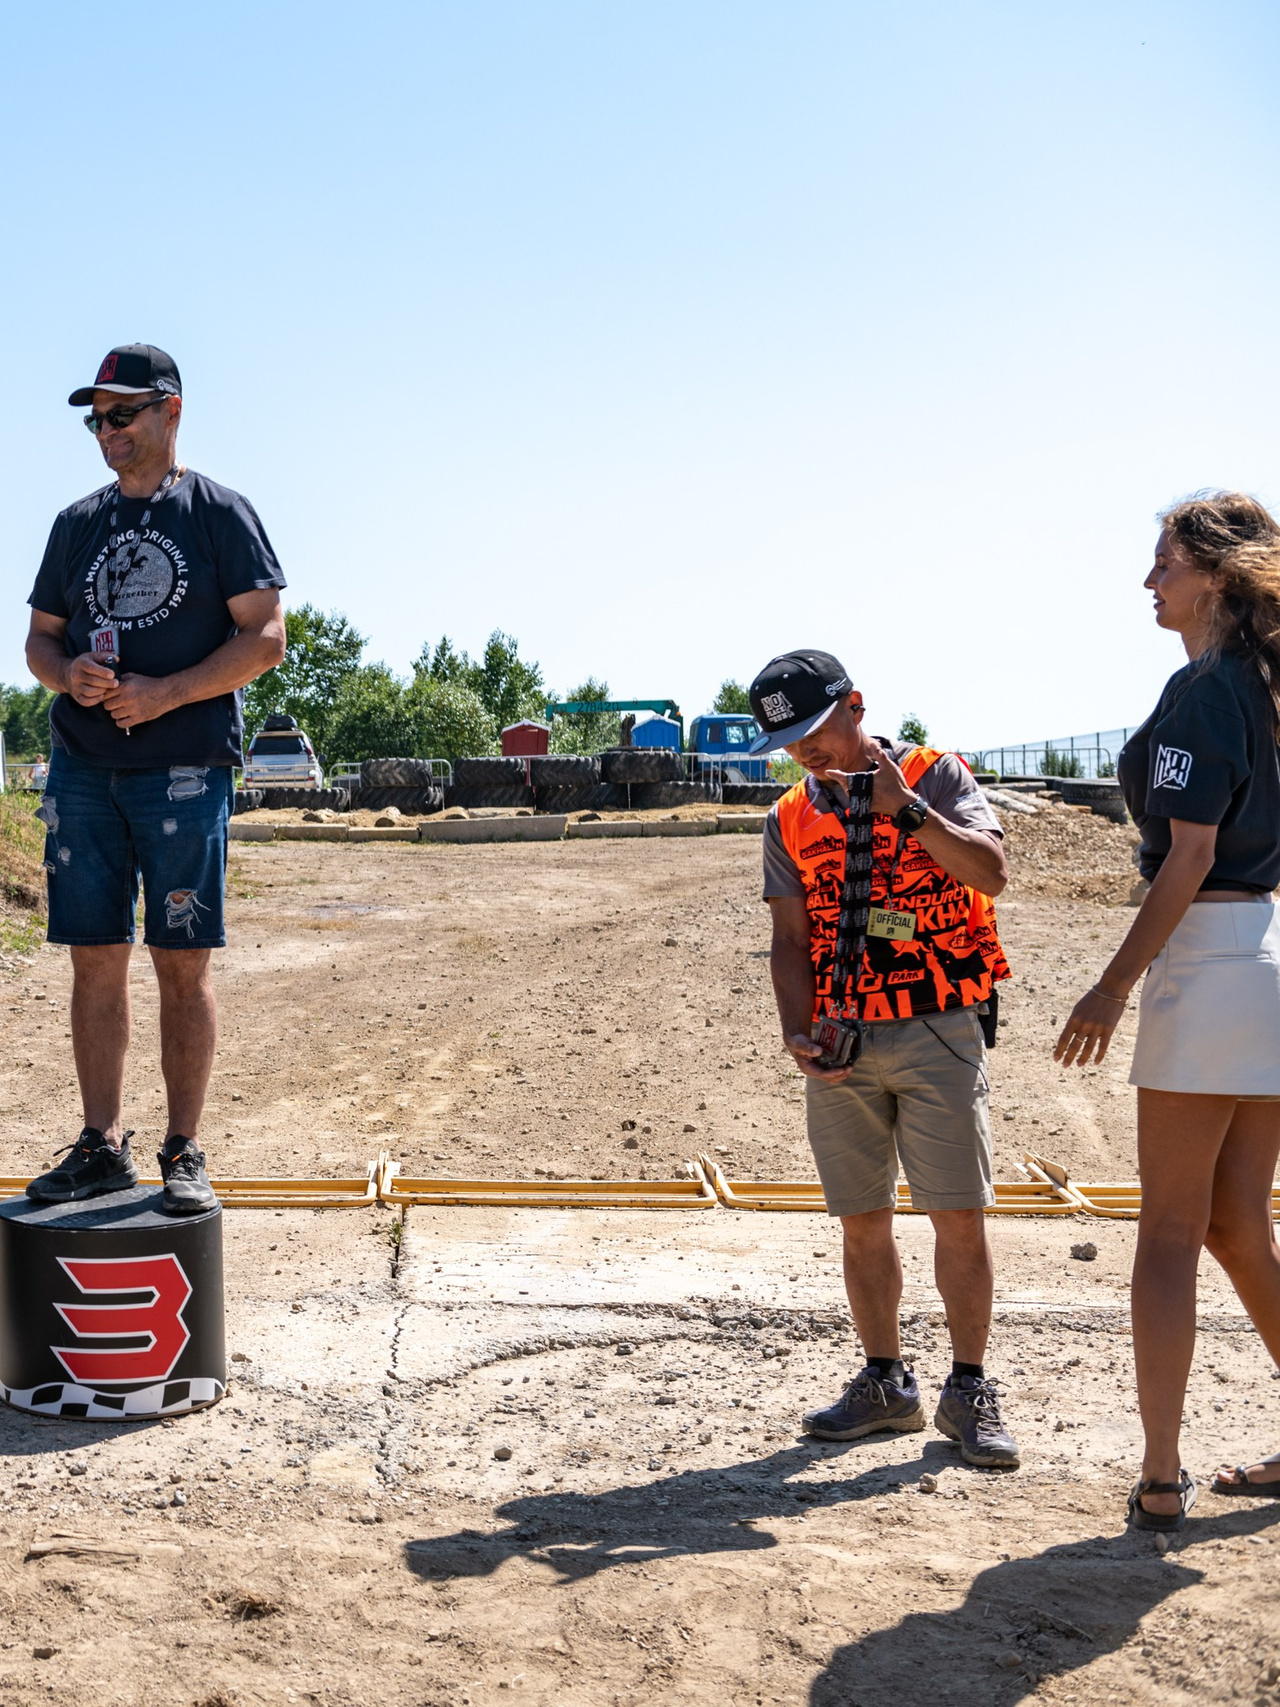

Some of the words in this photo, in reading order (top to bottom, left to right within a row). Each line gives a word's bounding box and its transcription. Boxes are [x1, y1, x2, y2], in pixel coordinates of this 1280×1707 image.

[85, 529, 135, 582] MUSTNG
[168, 580, 189, 608] 1932
[137, 607, 170, 629] ESTD
[876, 913, 912, 928] OFFICIAL
[891, 970, 921, 983] PARK
[50, 1252, 195, 1386] 3
